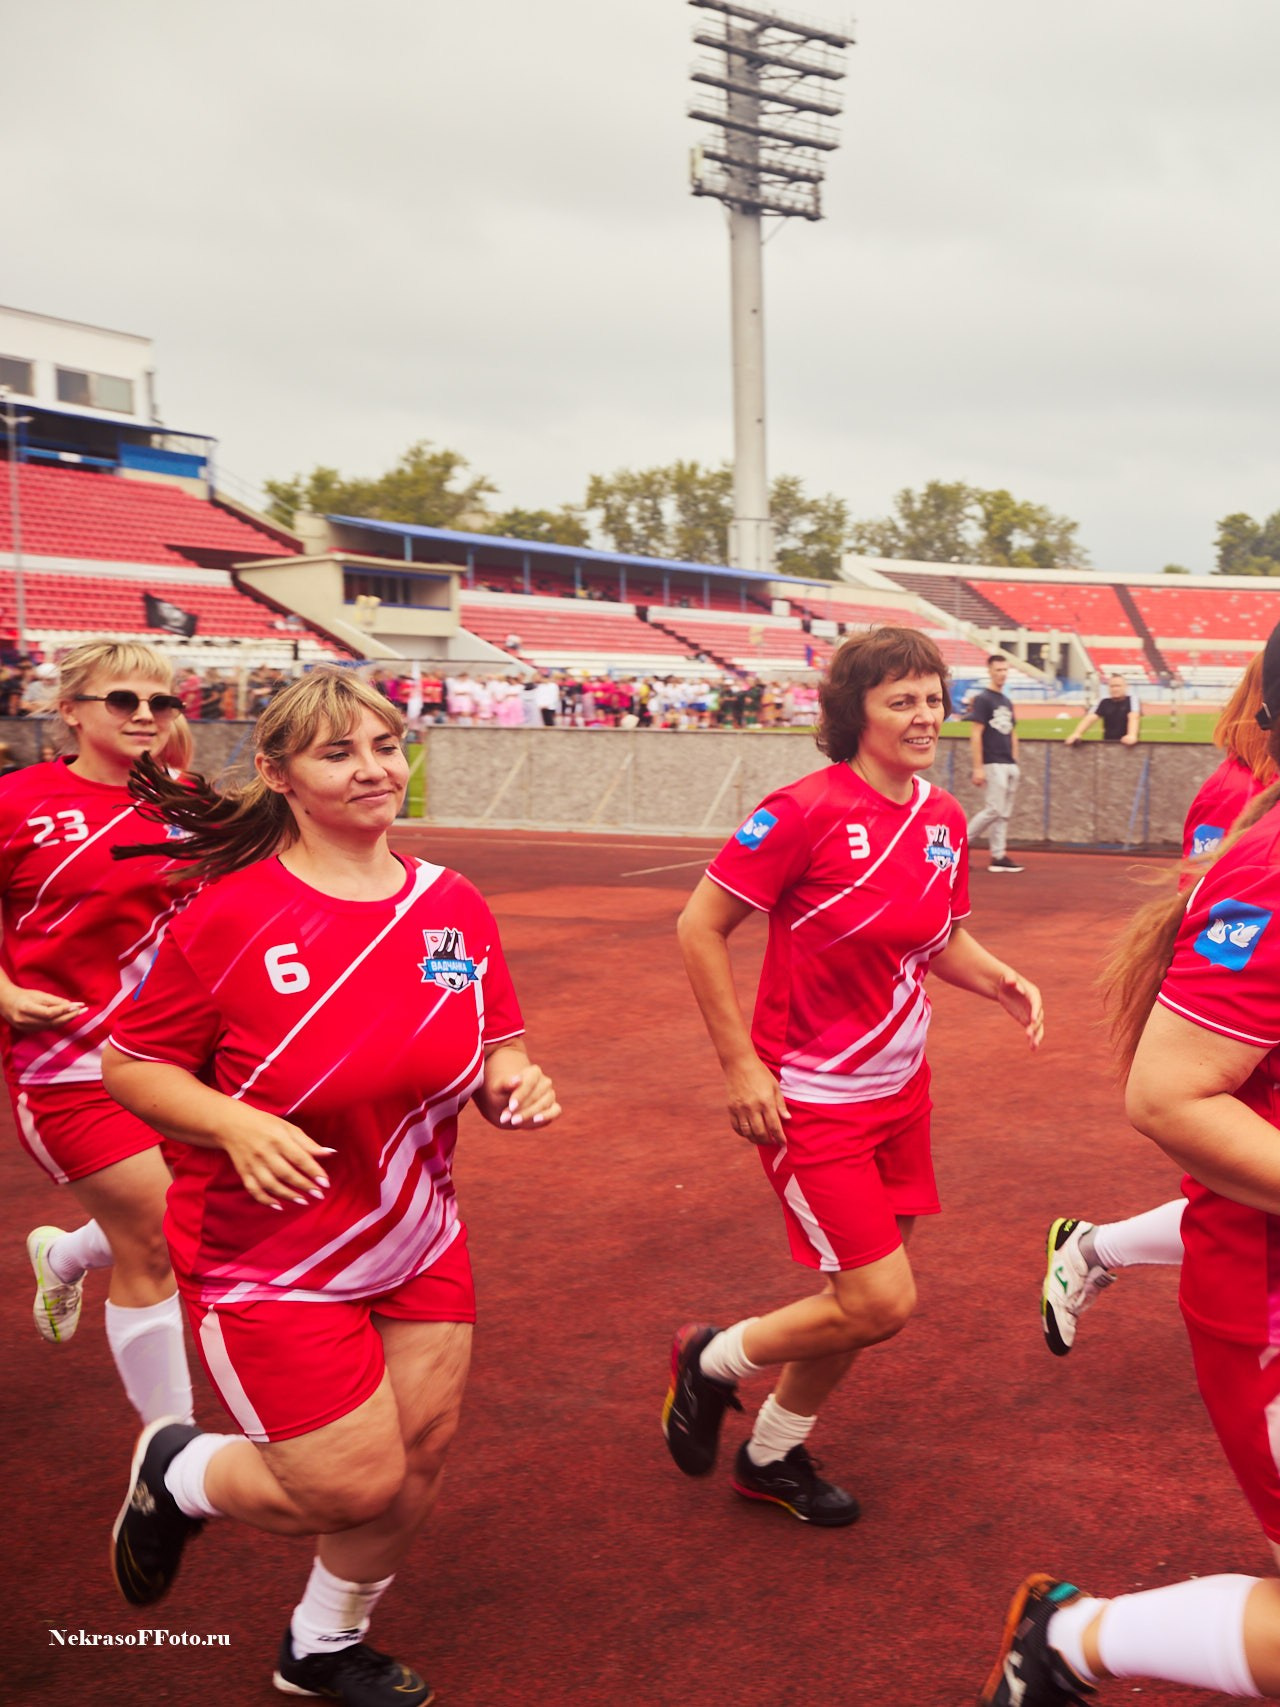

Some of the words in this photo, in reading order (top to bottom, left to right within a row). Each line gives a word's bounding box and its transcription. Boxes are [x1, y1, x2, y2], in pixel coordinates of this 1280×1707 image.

[27, 809, 89, 848] 23
[846, 823, 871, 859] 3
[264, 942, 310, 994] 6
